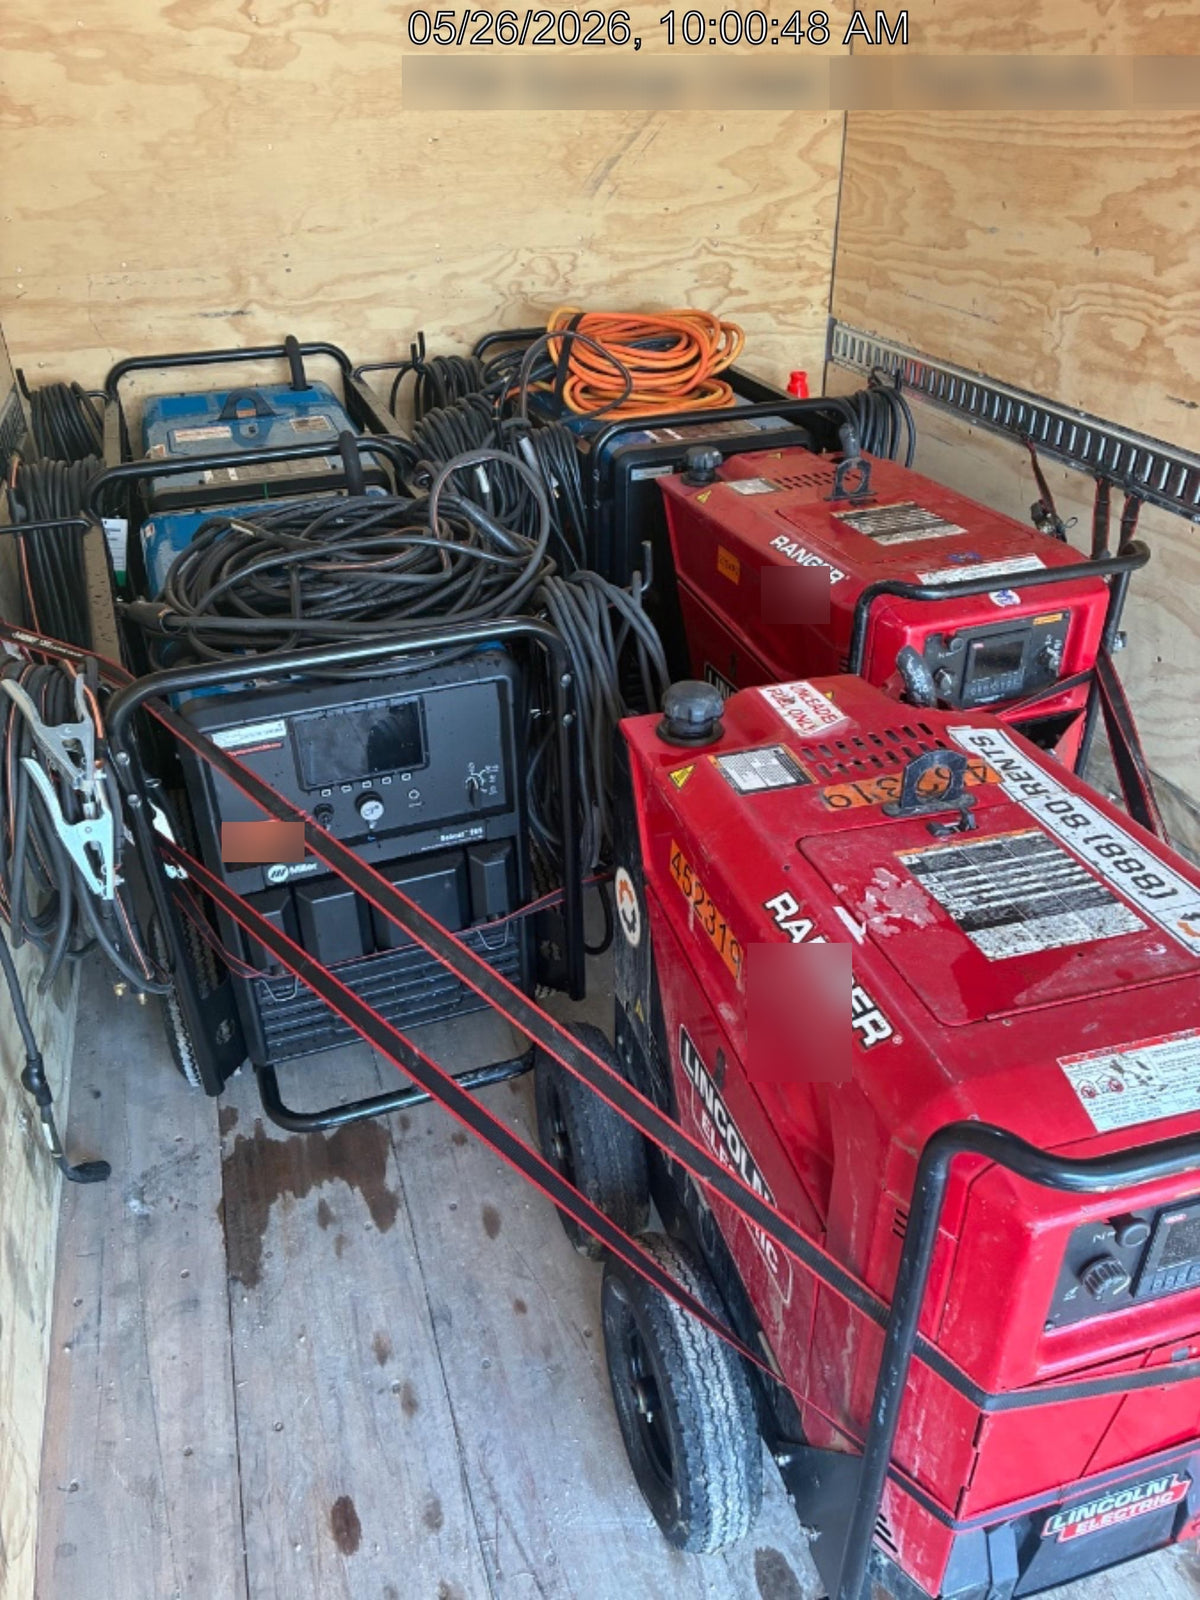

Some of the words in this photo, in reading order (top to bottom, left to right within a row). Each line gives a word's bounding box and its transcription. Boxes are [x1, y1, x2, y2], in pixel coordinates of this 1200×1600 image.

[769, 534, 846, 585] RANGR
[968, 735, 1091, 830] 80-RENTS
[1082, 833, 1178, 900] (888)
[763, 890, 894, 1050] RAER
[1052, 1477, 1171, 1531] LINCOLN
[1074, 1490, 1176, 1535] ELECTRIC
